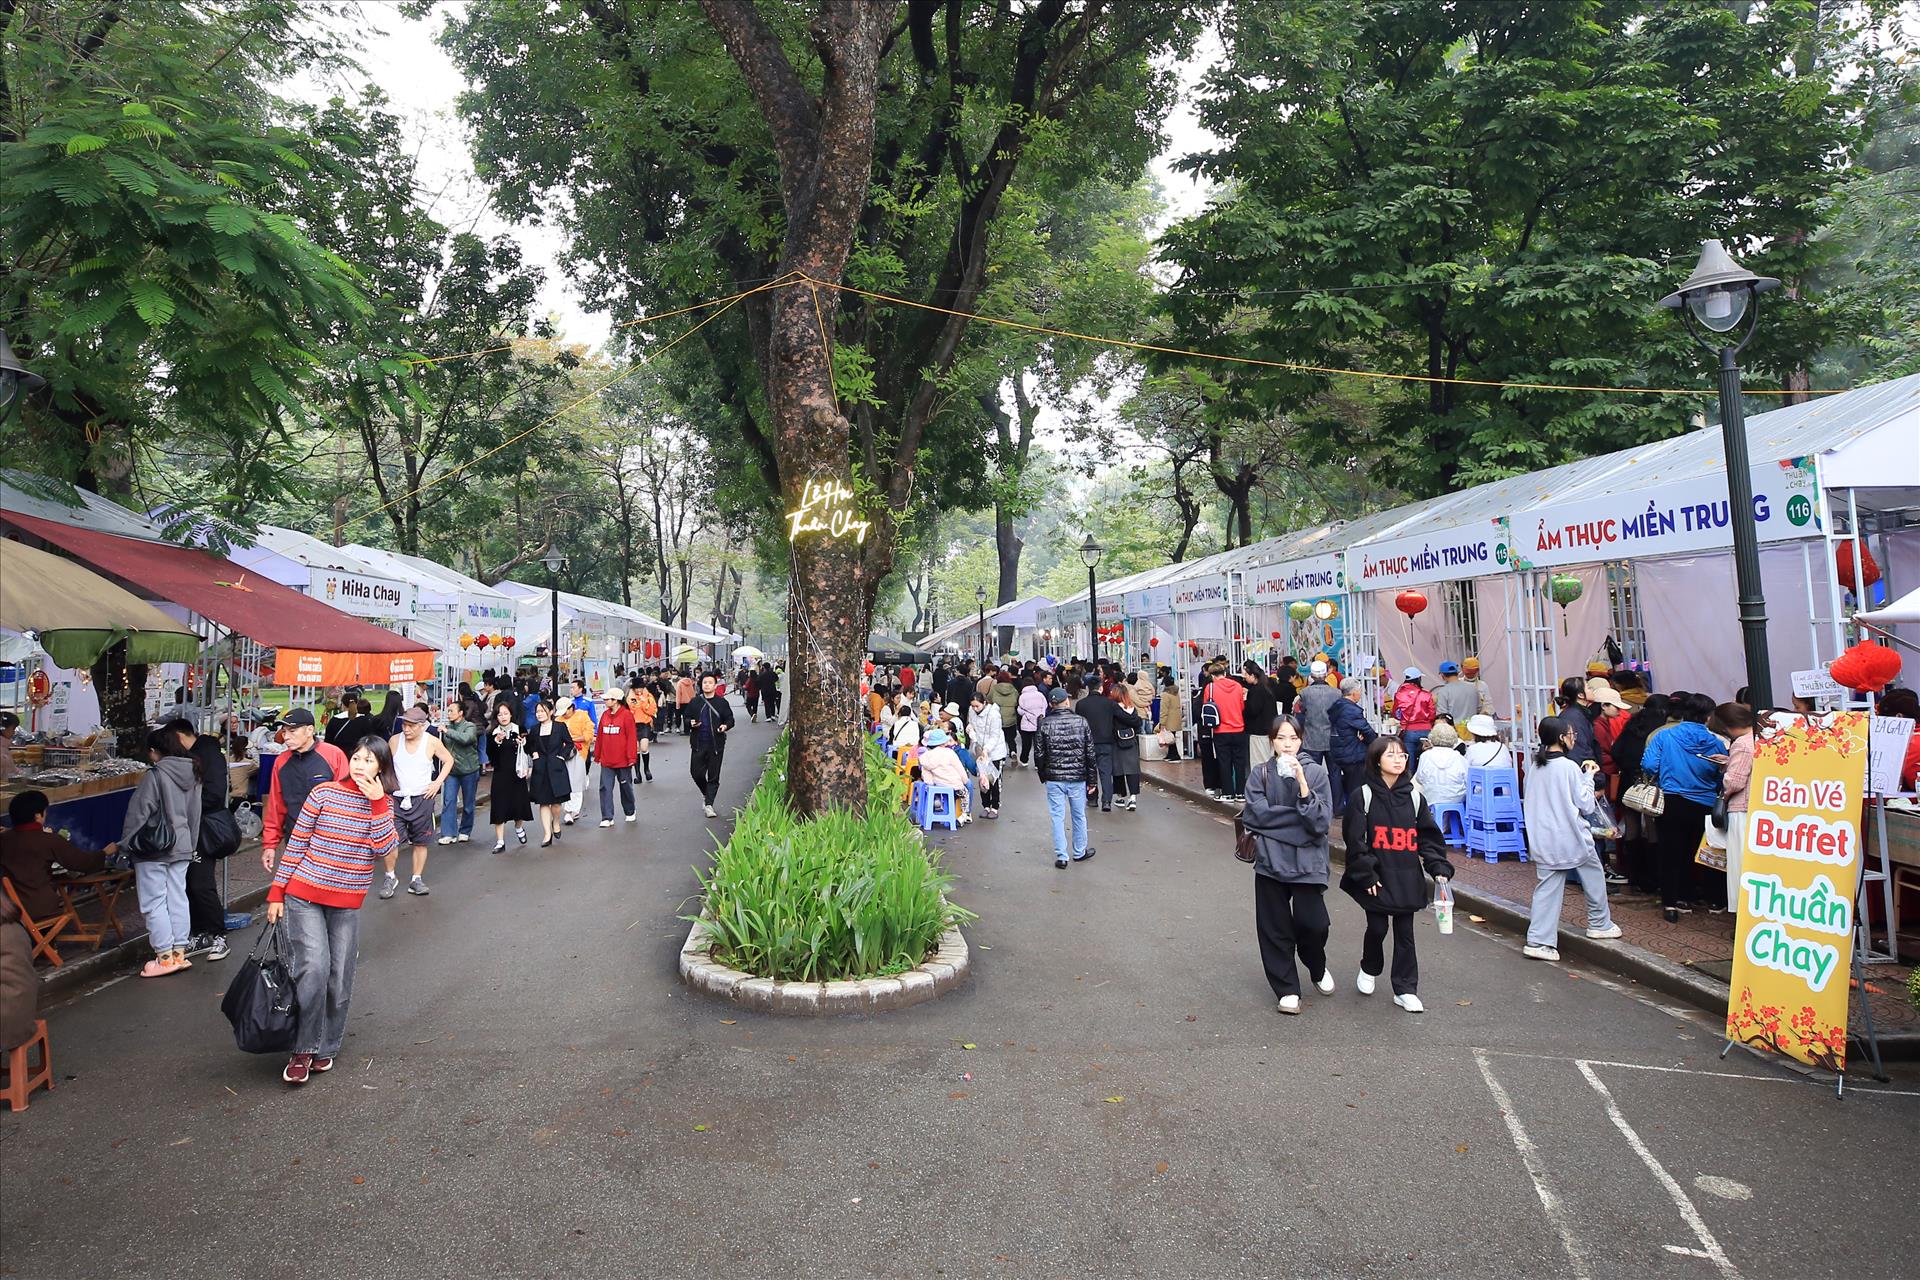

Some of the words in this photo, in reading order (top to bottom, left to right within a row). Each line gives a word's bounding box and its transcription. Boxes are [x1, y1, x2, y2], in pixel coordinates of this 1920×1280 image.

[1537, 518, 1562, 551] ẨM
[1565, 518, 1617, 551] THỰC
[1622, 500, 1676, 540] MIỀN
[1681, 494, 1770, 532] TRUG
[1789, 502, 1810, 519] 116
[831, 509, 872, 544] Chay
[1363, 554, 1377, 579] ẨM
[1379, 556, 1408, 579] THỰC
[1411, 543, 1440, 572] MIỀN
[1441, 541, 1488, 566] TRUNG
[1496, 548, 1507, 560] 115
[342, 579, 370, 598] HiHa
[373, 585, 400, 606] Chay
[1205, 586, 1221, 600] TRUNG
[1267, 578, 1284, 596] THỰC
[1286, 569, 1303, 590] MIỀN
[1305, 570, 1332, 588] TRUNG
[1766, 780, 1806, 804] Bán
[1814, 783, 1843, 808] Vé
[1372, 825, 1418, 852] ABC
[1755, 818, 1849, 858] Buffet
[1747, 879, 1846, 930] Thuần
[1751, 929, 1832, 985] Chay
